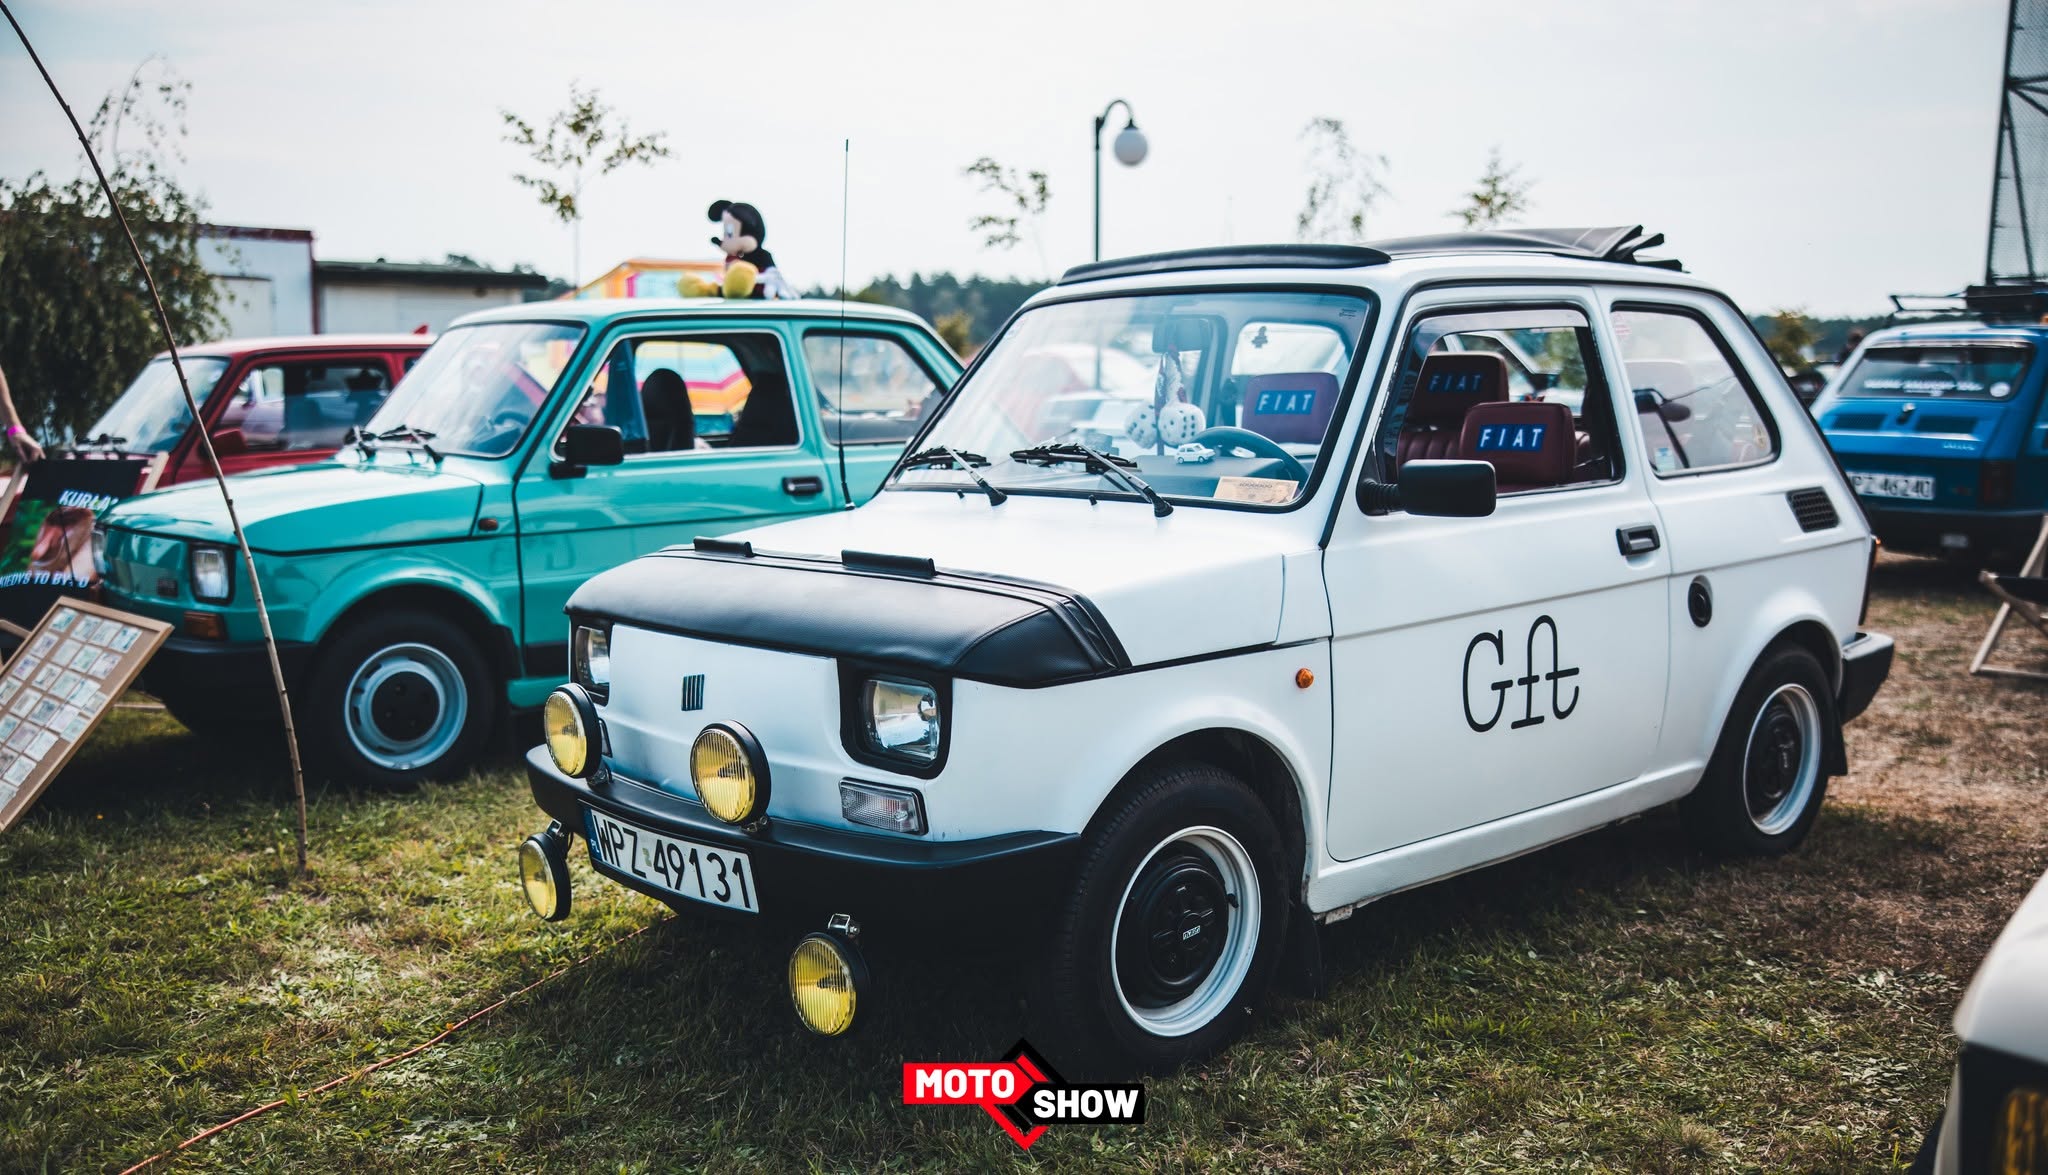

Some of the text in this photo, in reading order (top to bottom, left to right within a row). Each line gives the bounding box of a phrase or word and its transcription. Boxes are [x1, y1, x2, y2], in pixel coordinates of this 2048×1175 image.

[1428, 374, 1481, 392] FIAT
[1258, 394, 1312, 411] FIAT
[1479, 428, 1542, 448] FIAT
[34, 571, 51, 585] TO
[593, 814, 752, 909] WPZ 49131
